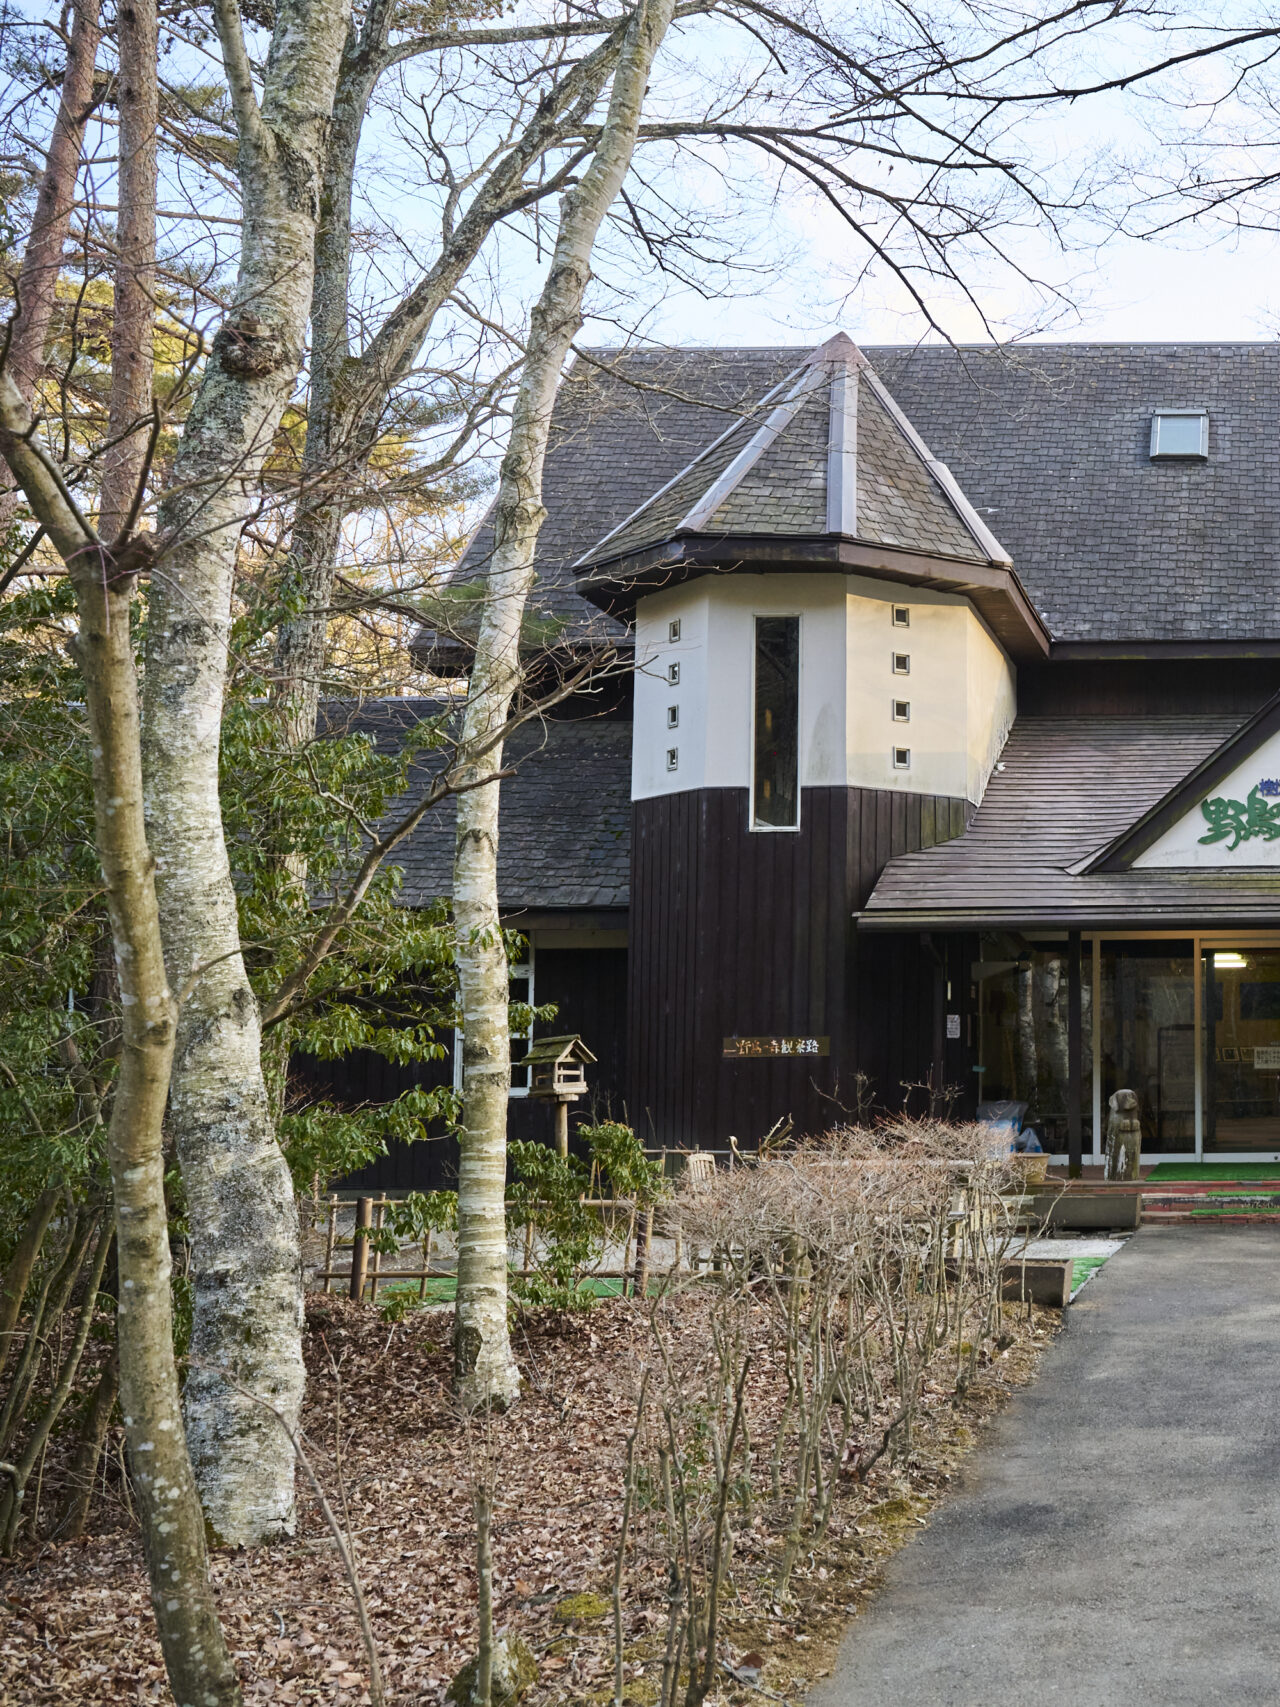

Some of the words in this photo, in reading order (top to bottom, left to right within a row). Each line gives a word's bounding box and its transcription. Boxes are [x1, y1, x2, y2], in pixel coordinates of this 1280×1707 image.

[735, 1038, 820, 1055] 野鳥森観察路
